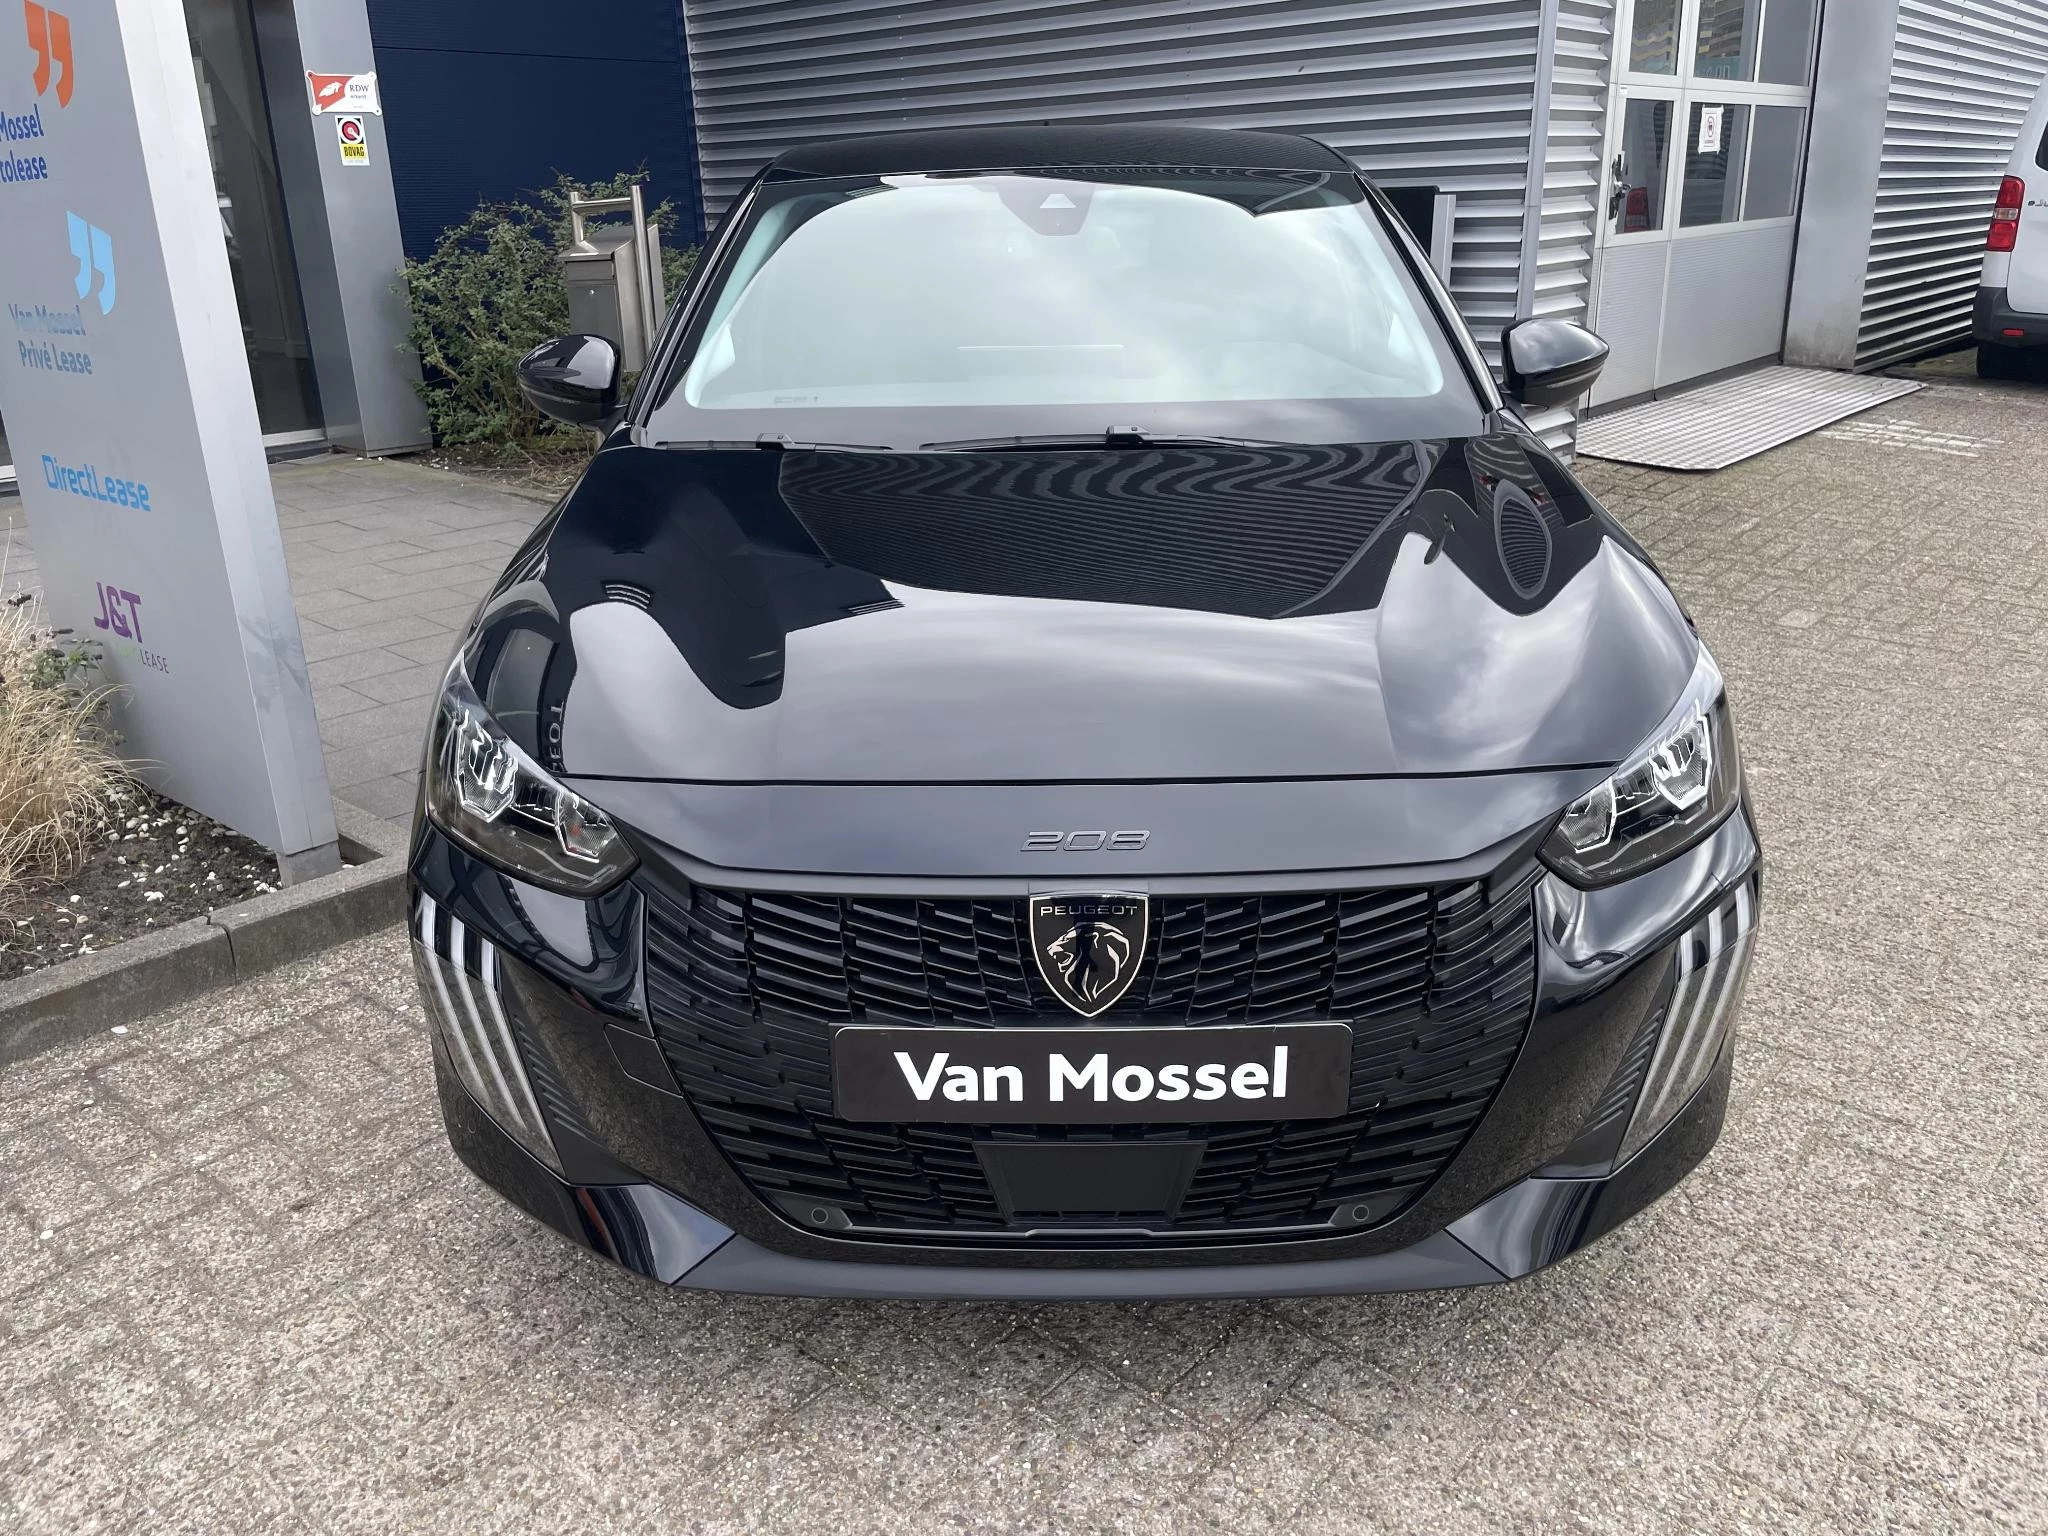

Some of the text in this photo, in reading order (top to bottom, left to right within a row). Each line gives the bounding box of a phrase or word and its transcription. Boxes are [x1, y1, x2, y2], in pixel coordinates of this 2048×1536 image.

[349, 84, 370, 92] RDW
[343, 146, 365, 157] BOVAG
[18, 339, 92, 375] Privé Lease
[41, 454, 151, 512] DirectLease
[93, 582, 143, 644] J&T
[138, 648, 170, 675] LEASE
[1020, 830, 1150, 852] 208
[1040, 904, 1138, 917] PEUGEOT
[893, 1045, 1289, 1103] Van Mossel
